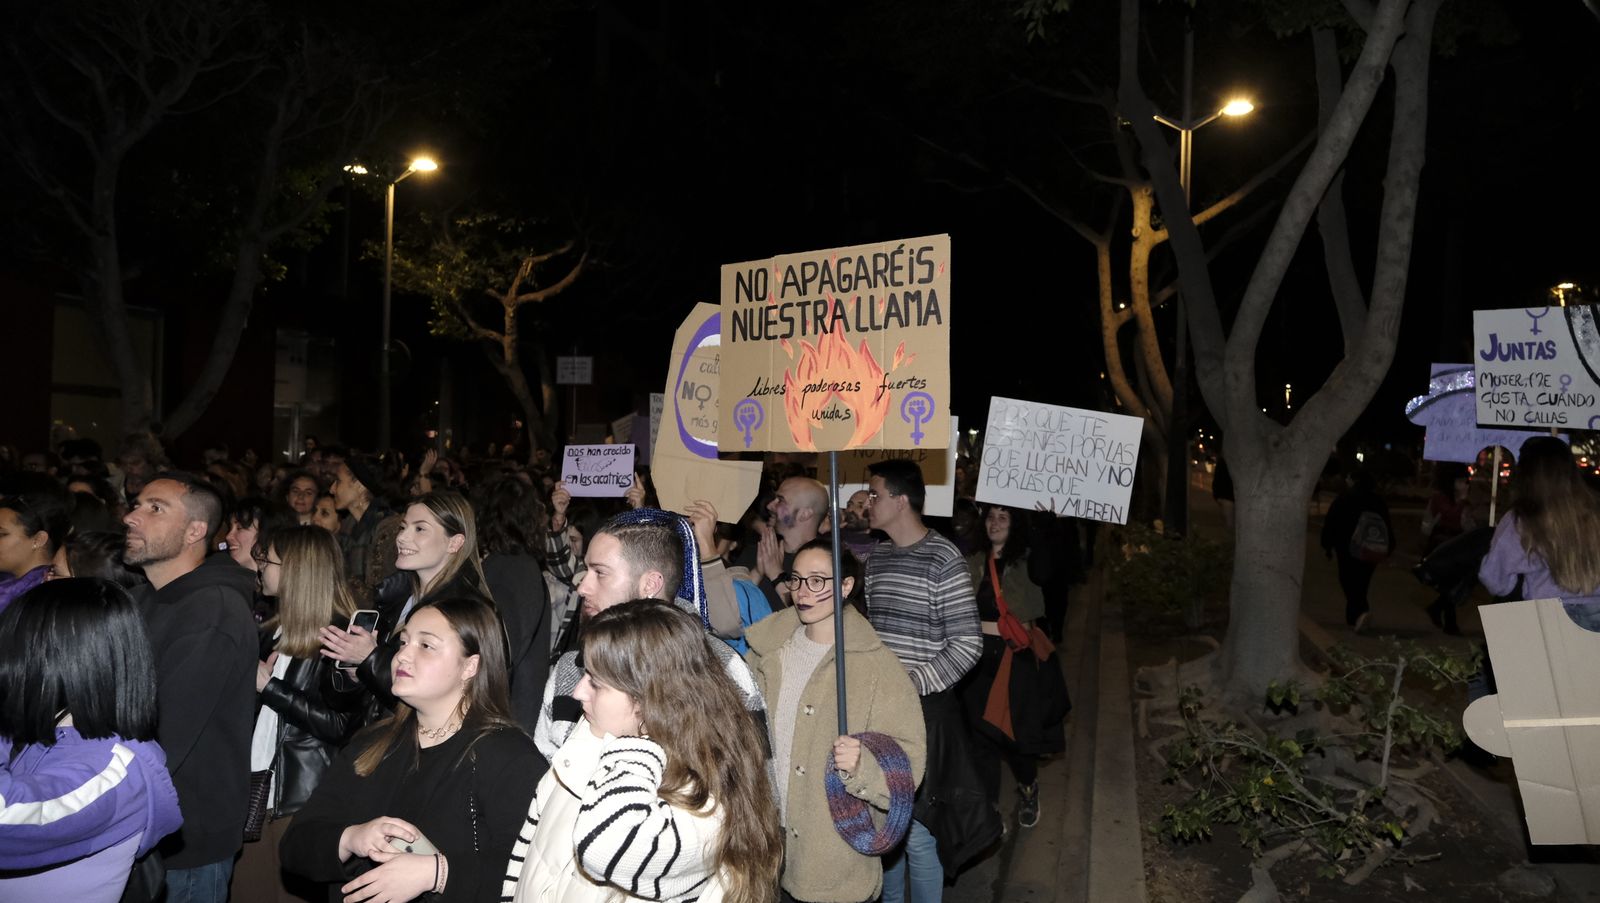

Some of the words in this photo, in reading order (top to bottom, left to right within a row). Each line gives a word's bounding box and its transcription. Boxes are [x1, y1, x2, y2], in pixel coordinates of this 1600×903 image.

[735, 268, 768, 303] NO
[731, 298, 850, 342] NUESTRA
[855, 288, 942, 332] LLAMA
[747, 376, 786, 398] libres
[802, 380, 861, 410] poderosas
[878, 373, 927, 402] fuertes
[1481, 392, 1528, 408] GUSTA
[1536, 393, 1595, 407] CUANDO
[811, 403, 851, 421] unidas
[993, 402, 1029, 426] POR
[1035, 407, 1073, 432] QUE
[1079, 415, 1108, 437] TE
[1496, 409, 1515, 423] NO
[1524, 411, 1568, 424] CALLAS
[587, 448, 601, 456] han
[603, 445, 631, 456] crecido
[985, 425, 1067, 454] ESPANTES
[1070, 434, 1106, 459] POR
[1105, 440, 1135, 466] LAS
[579, 473, 592, 486] las
[983, 447, 1021, 468] QUE
[1026, 452, 1089, 477] LUCHAN
[1096, 463, 1106, 483] Y
[1108, 465, 1133, 488] NO
[986, 467, 1019, 489] POR
[1020, 472, 1043, 492] LAS
[1047, 475, 1084, 496] QUE
[1061, 497, 1123, 523] MUEREN
